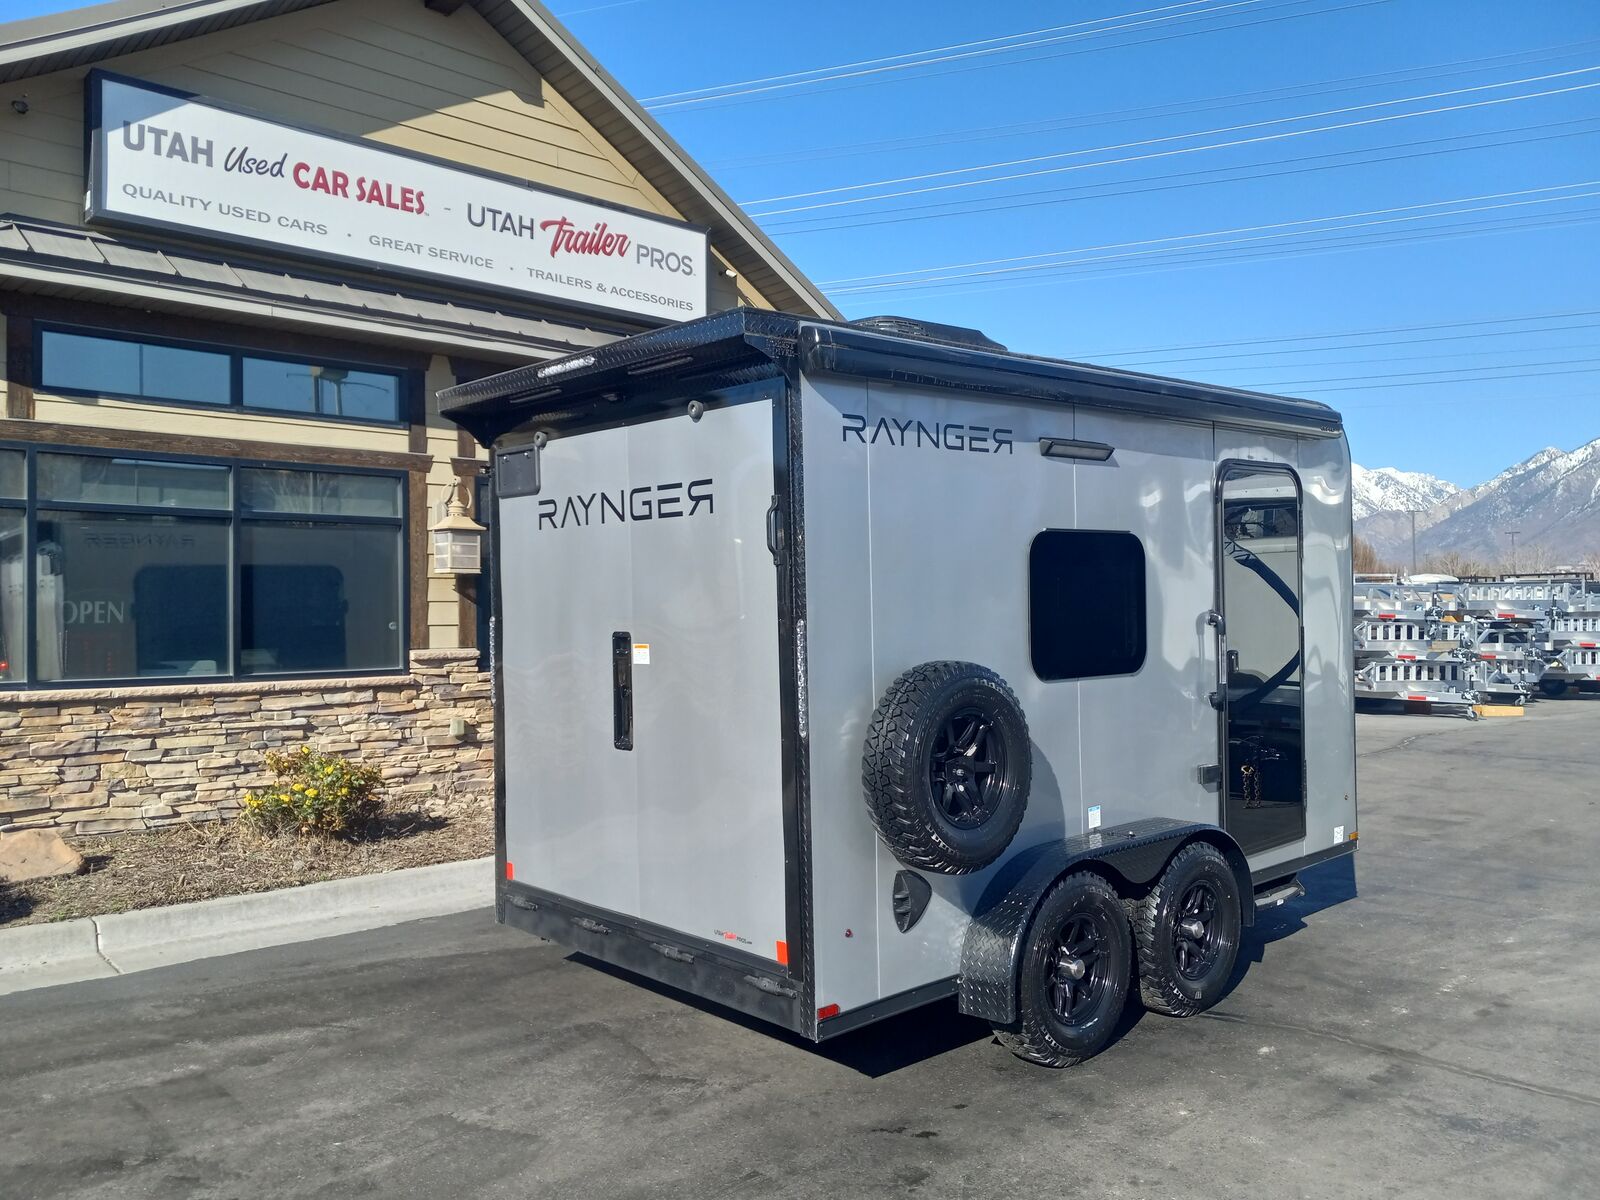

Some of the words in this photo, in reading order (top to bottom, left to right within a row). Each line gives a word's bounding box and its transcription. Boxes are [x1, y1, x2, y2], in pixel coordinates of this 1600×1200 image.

[122, 120, 214, 168] UTAH
[223, 145, 288, 178] Used
[292, 161, 350, 199] CAR
[355, 175, 426, 215] SALES
[467, 202, 535, 240] UTAH
[539, 215, 631, 258] Trailer
[636, 243, 694, 277] PROS
[122, 183, 212, 211] QUALITY
[218, 202, 271, 224] USED
[277, 215, 328, 235] CARS
[368, 234, 424, 256] GREAT
[428, 246, 494, 269] SERVICE
[527, 267, 593, 291] TRAILERS
[596, 282, 607, 293] &
[610, 285, 694, 311] ACCESSORIES
[842, 413, 1013, 455] RAYNGER
[538, 478, 714, 530] RAYNGER
[62, 600, 124, 624] OPEN
